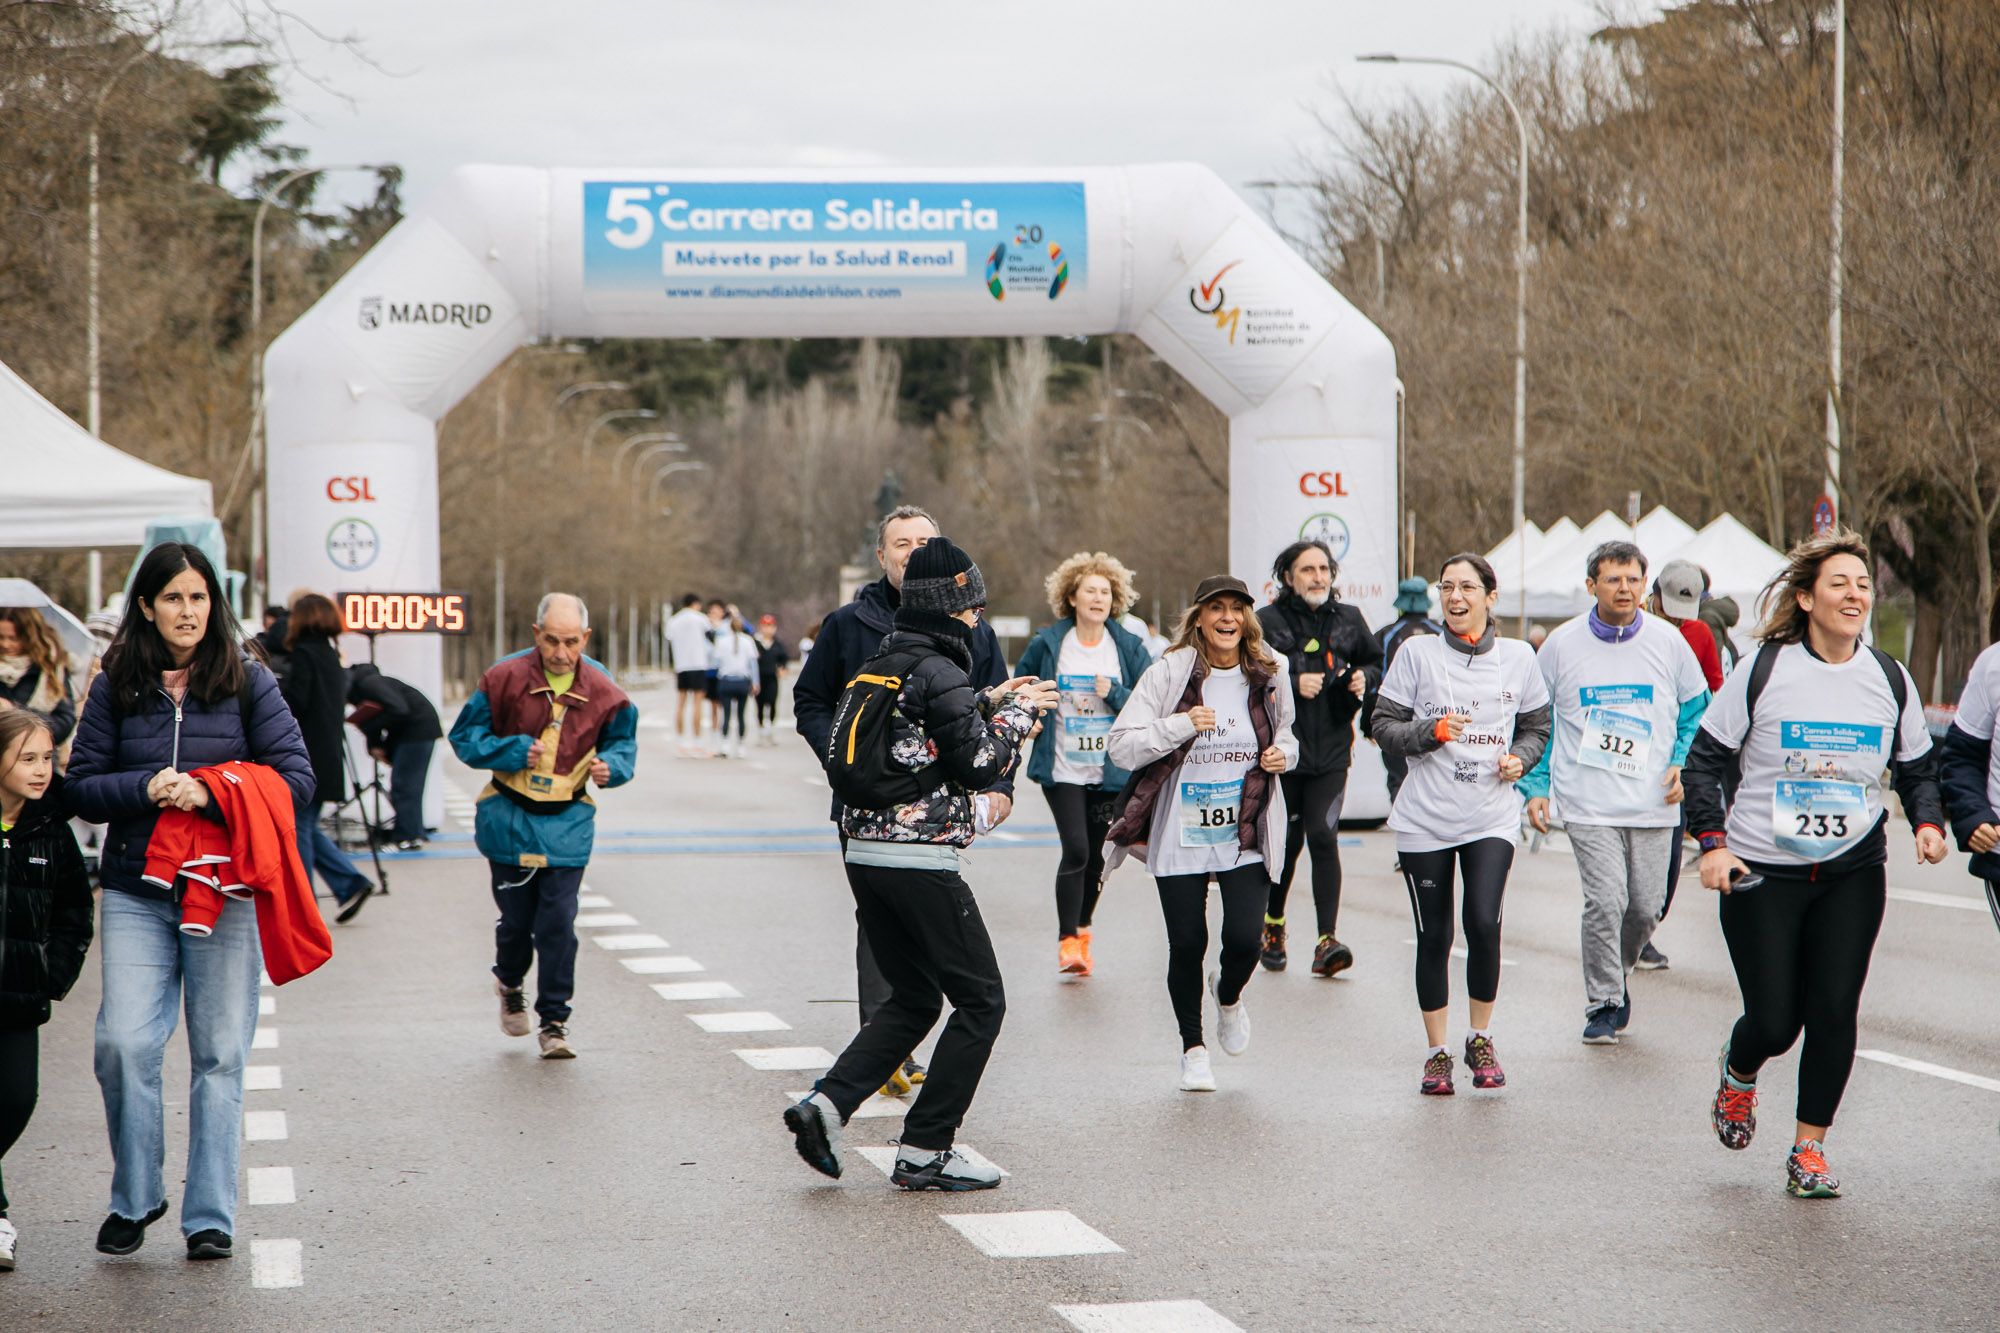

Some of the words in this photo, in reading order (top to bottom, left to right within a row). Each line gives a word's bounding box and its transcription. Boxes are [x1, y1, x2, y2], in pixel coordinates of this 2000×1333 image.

[659, 199, 813, 231] Carrera
[824, 199, 999, 231] Solidaria
[676, 249, 761, 266] Muévete
[769, 254, 802, 270] por
[810, 249, 827, 266] la
[835, 249, 891, 266] Salud
[897, 249, 954, 266] Renal
[389, 303, 492, 329] MADRID
[327, 476, 376, 502] CSL
[1300, 472, 1349, 497] CSL
[1078, 736, 1104, 751] 118
[1192, 743, 1211, 751] uede
[1600, 733, 1634, 757] 312
[1184, 751, 1258, 766] ALUDRENA
[1200, 806, 1236, 827] 181
[1796, 814, 1849, 838] 233
